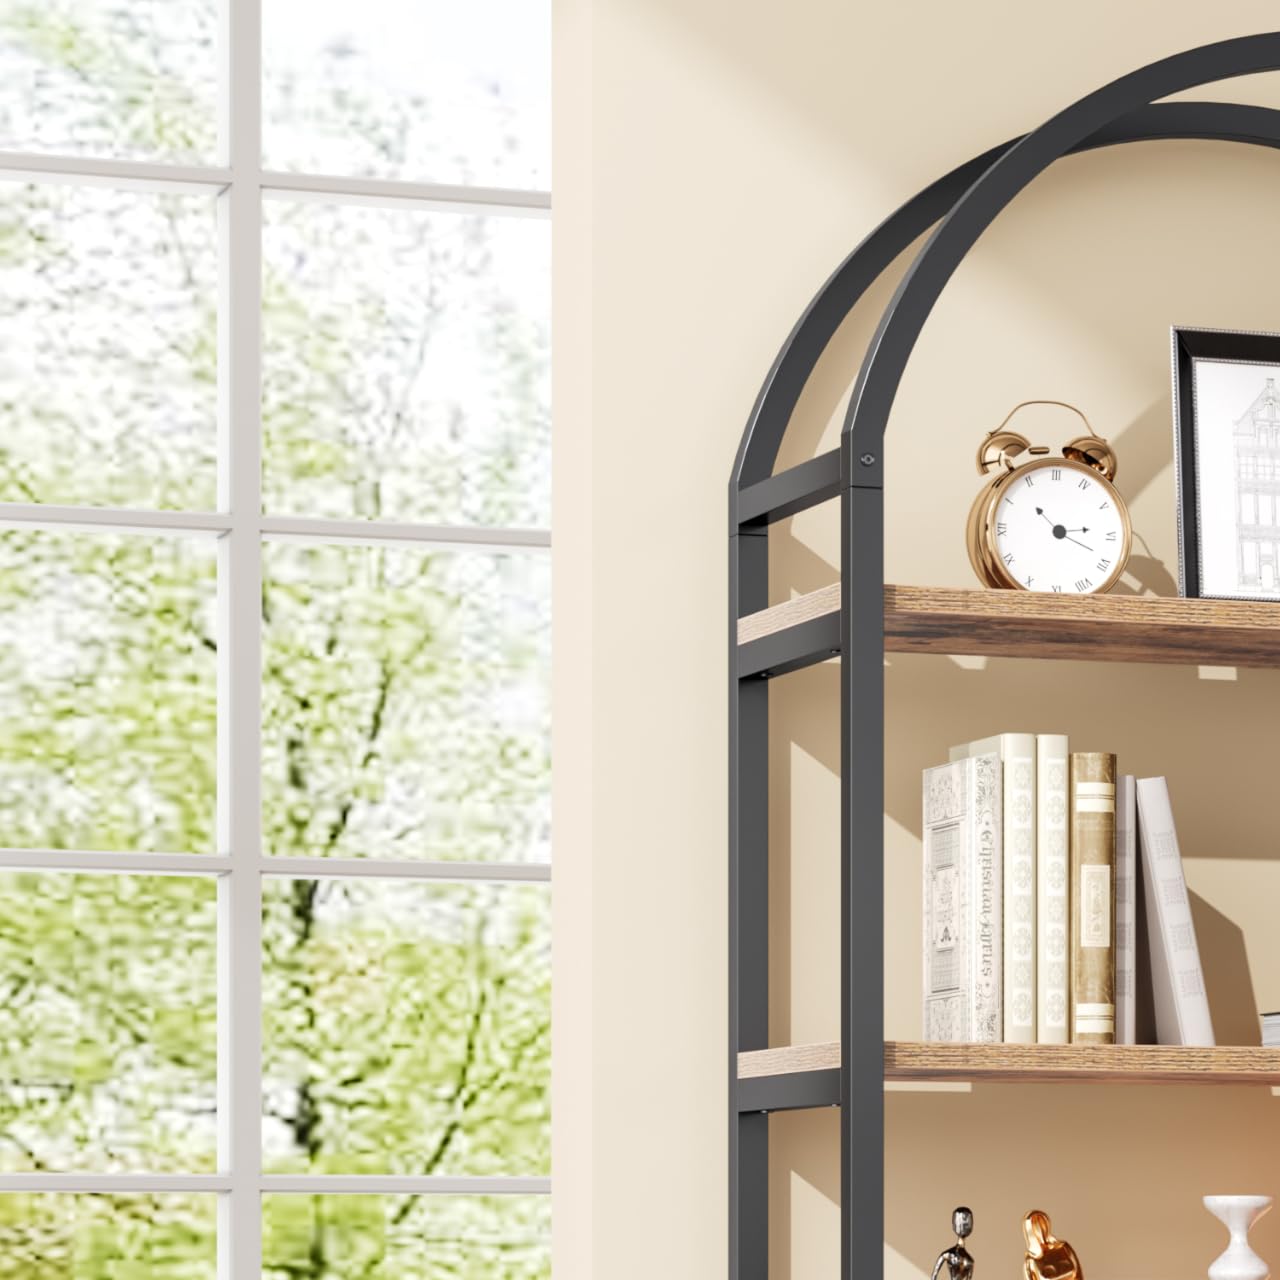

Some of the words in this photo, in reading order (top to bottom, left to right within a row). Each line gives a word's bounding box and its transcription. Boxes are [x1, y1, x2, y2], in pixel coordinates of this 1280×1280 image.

[1051, 469, 1061, 481] III
[1024, 475, 1034, 488] II
[1078, 478, 1091, 490] IV
[1099, 502, 1110, 510] V
[997, 522, 1007, 537] XII
[1105, 531, 1117, 541] VI
[1096, 558, 1111, 573] VII
[1024, 575, 1035, 587] X
[1074, 577, 1093, 592] VIII
